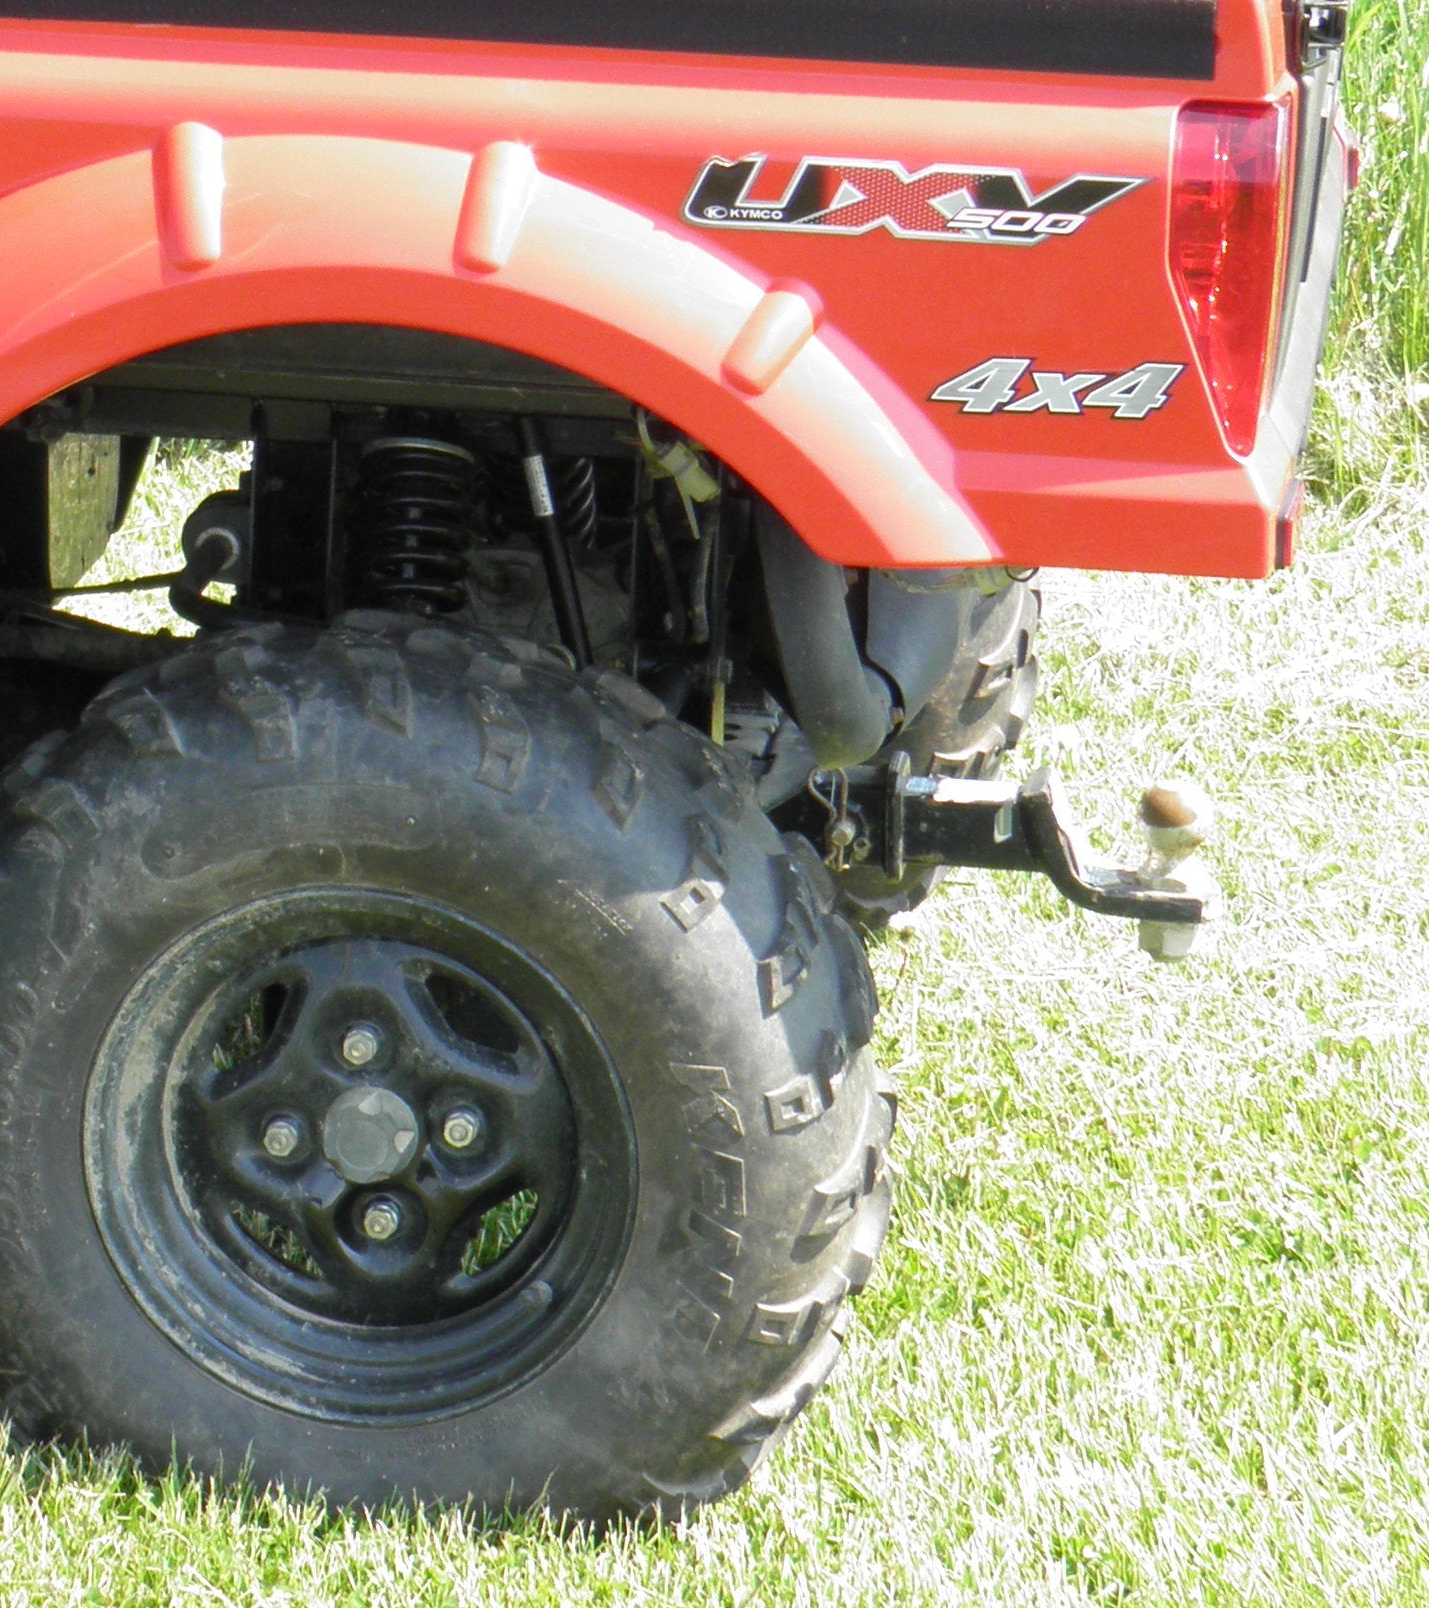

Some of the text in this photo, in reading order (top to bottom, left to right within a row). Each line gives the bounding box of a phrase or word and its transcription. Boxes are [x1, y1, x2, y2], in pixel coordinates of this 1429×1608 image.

[684, 153, 1151, 246] UXV
[729, 209, 783, 220] KYMCO
[947, 208, 1087, 234] 500
[928, 357, 1188, 420] 4x4
